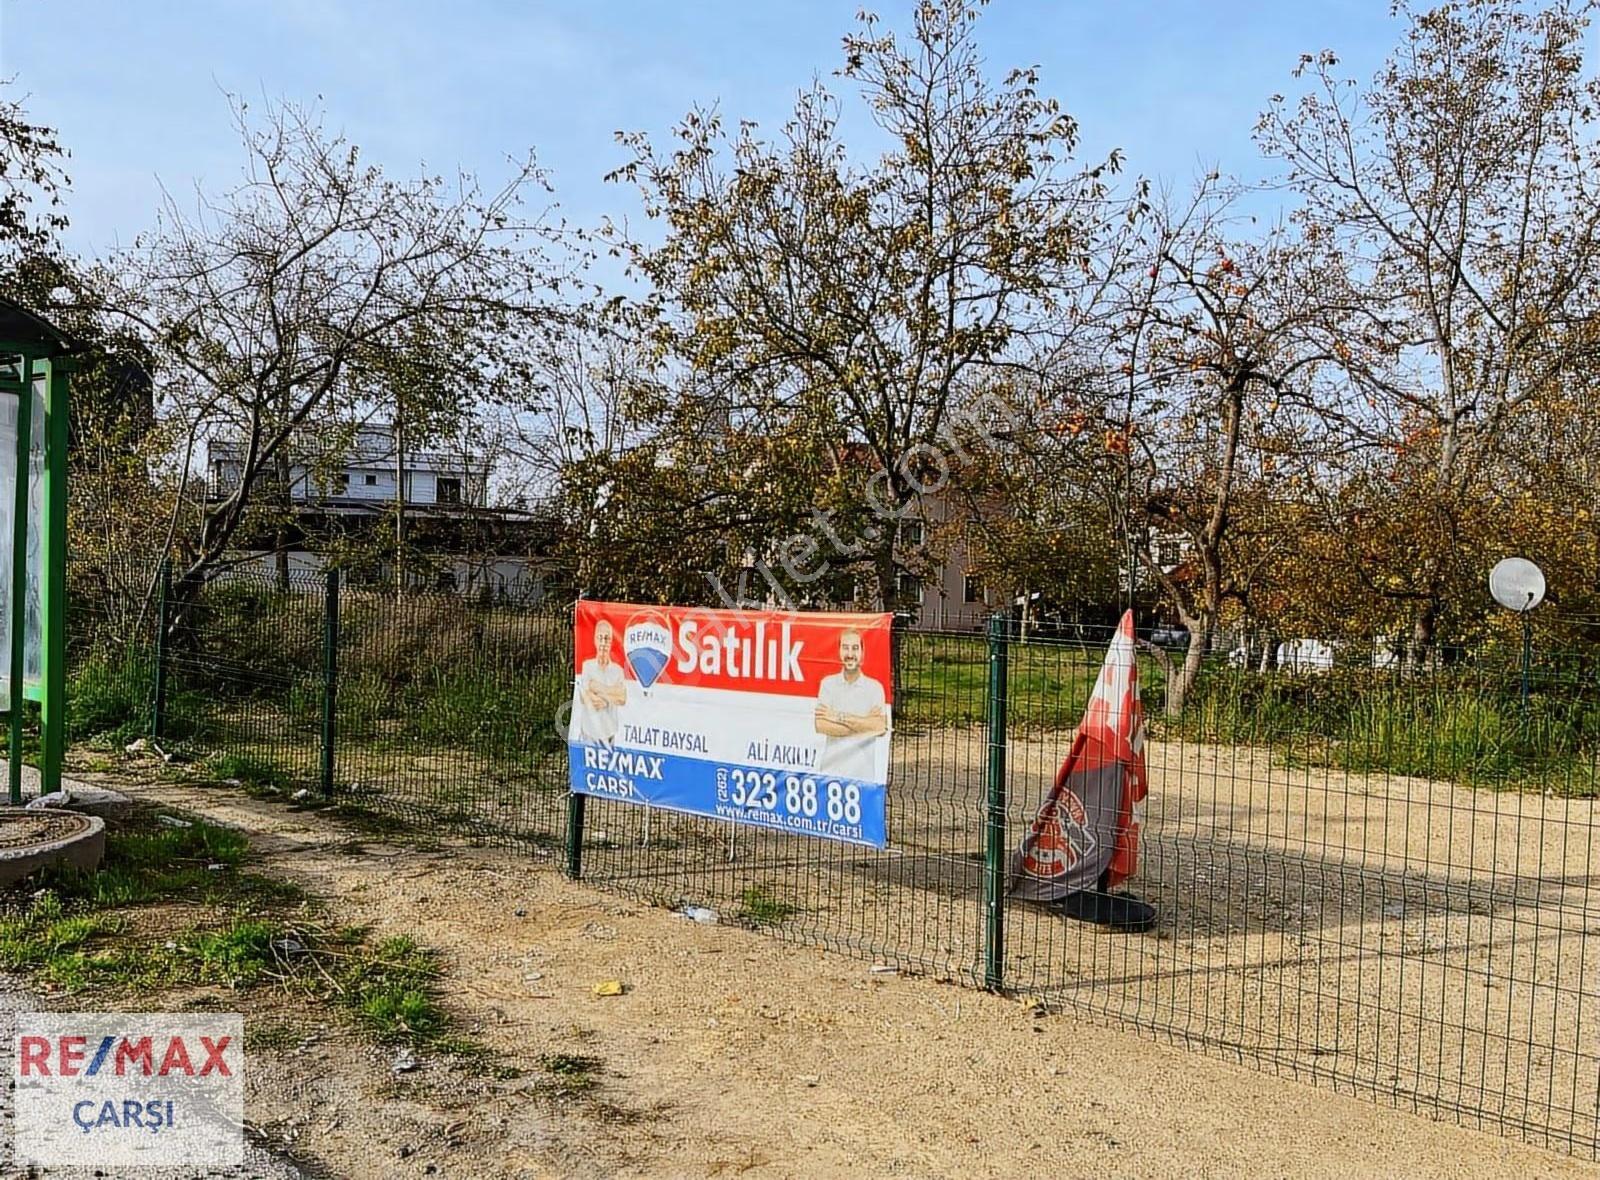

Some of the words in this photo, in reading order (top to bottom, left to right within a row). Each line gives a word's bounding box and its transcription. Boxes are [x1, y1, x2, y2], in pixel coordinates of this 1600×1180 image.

[629, 629, 667, 648] RE/MAX
[677, 620, 805, 682] Satılık
[623, 724, 660, 748] TALAT
[662, 730, 709, 753] BAYSAL
[746, 738, 769, 762] ALİ
[584, 746, 664, 780] RE/MAX
[586, 772, 634, 798] ÇARŞI
[716, 767, 730, 803] (262)
[731, 768, 778, 811] 323
[785, 776, 818, 817] 88
[827, 781, 861, 824] 88
[715, 803, 863, 839] www.remax.com.tr/carsi
